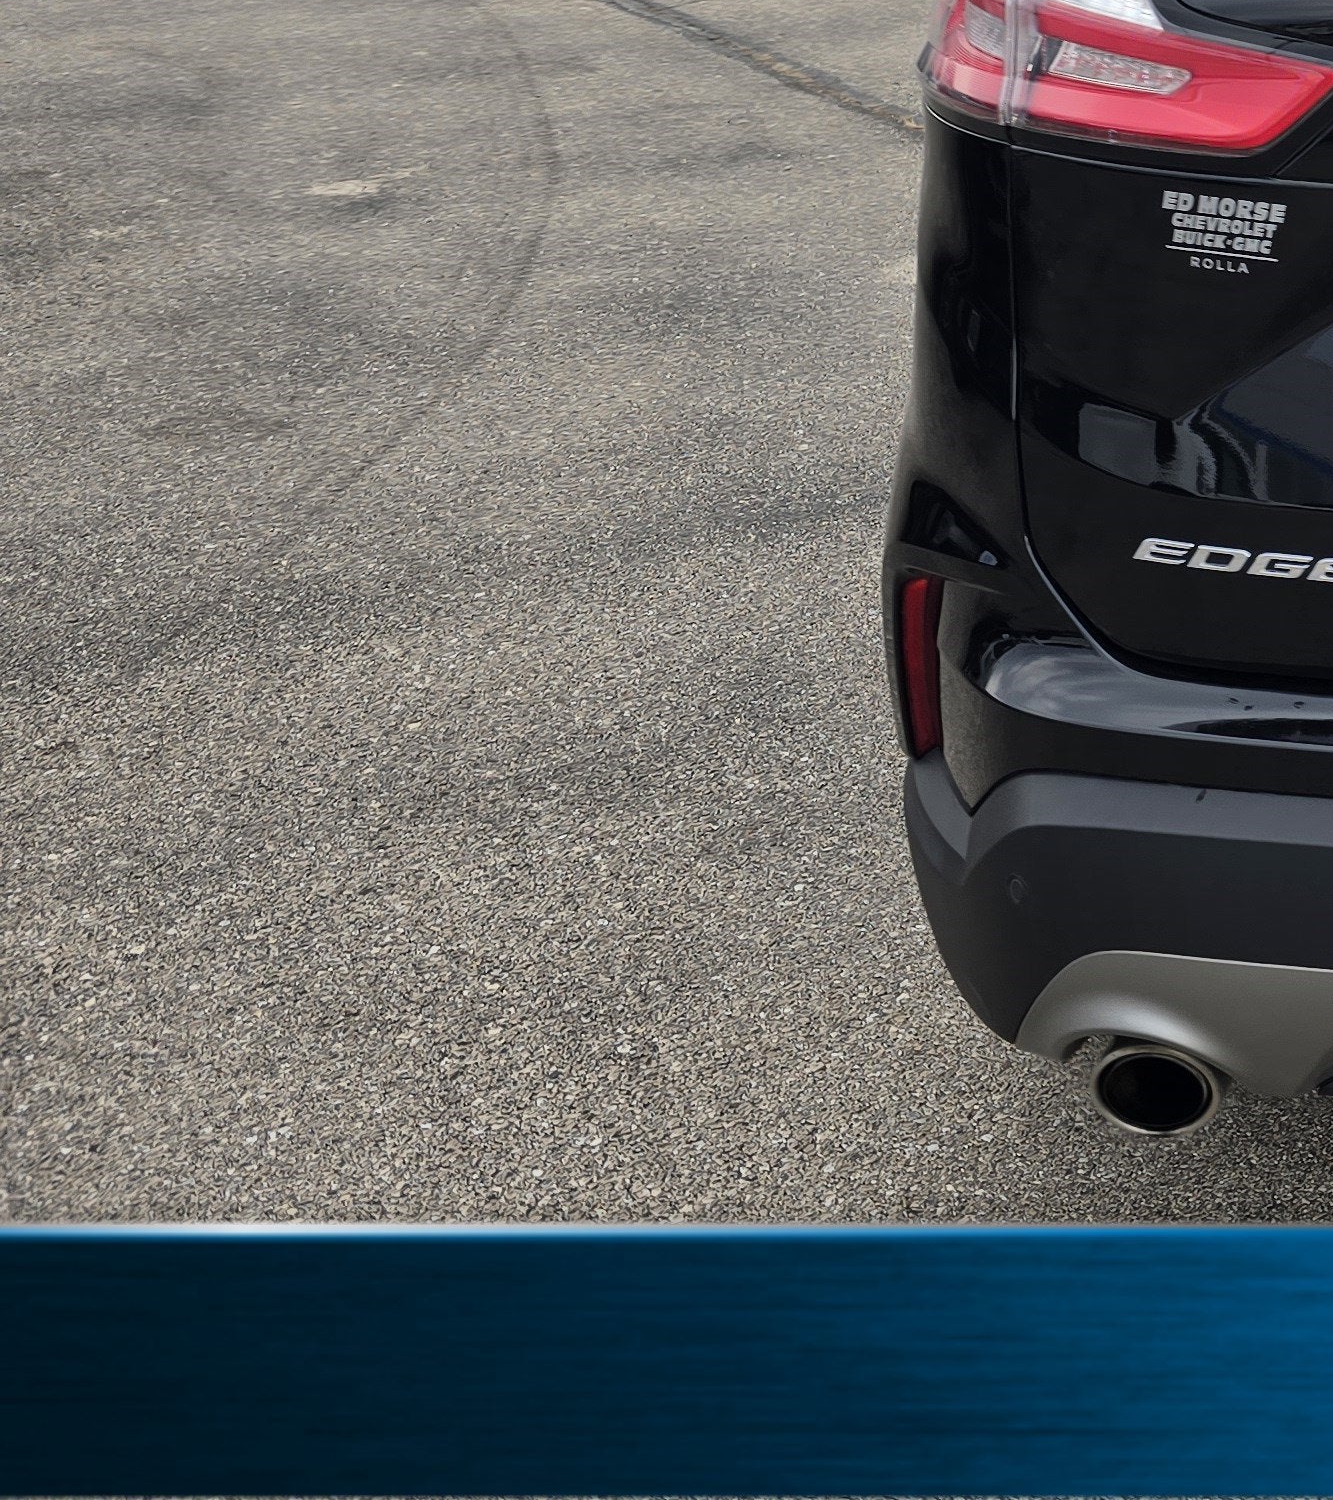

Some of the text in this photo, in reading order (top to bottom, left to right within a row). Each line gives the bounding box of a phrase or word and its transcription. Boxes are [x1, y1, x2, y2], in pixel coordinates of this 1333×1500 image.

[1161, 189, 1288, 224] ED MORSE
[1170, 211, 1278, 239] CHEVROLET
[1188, 255, 1250, 274] ROLLA
